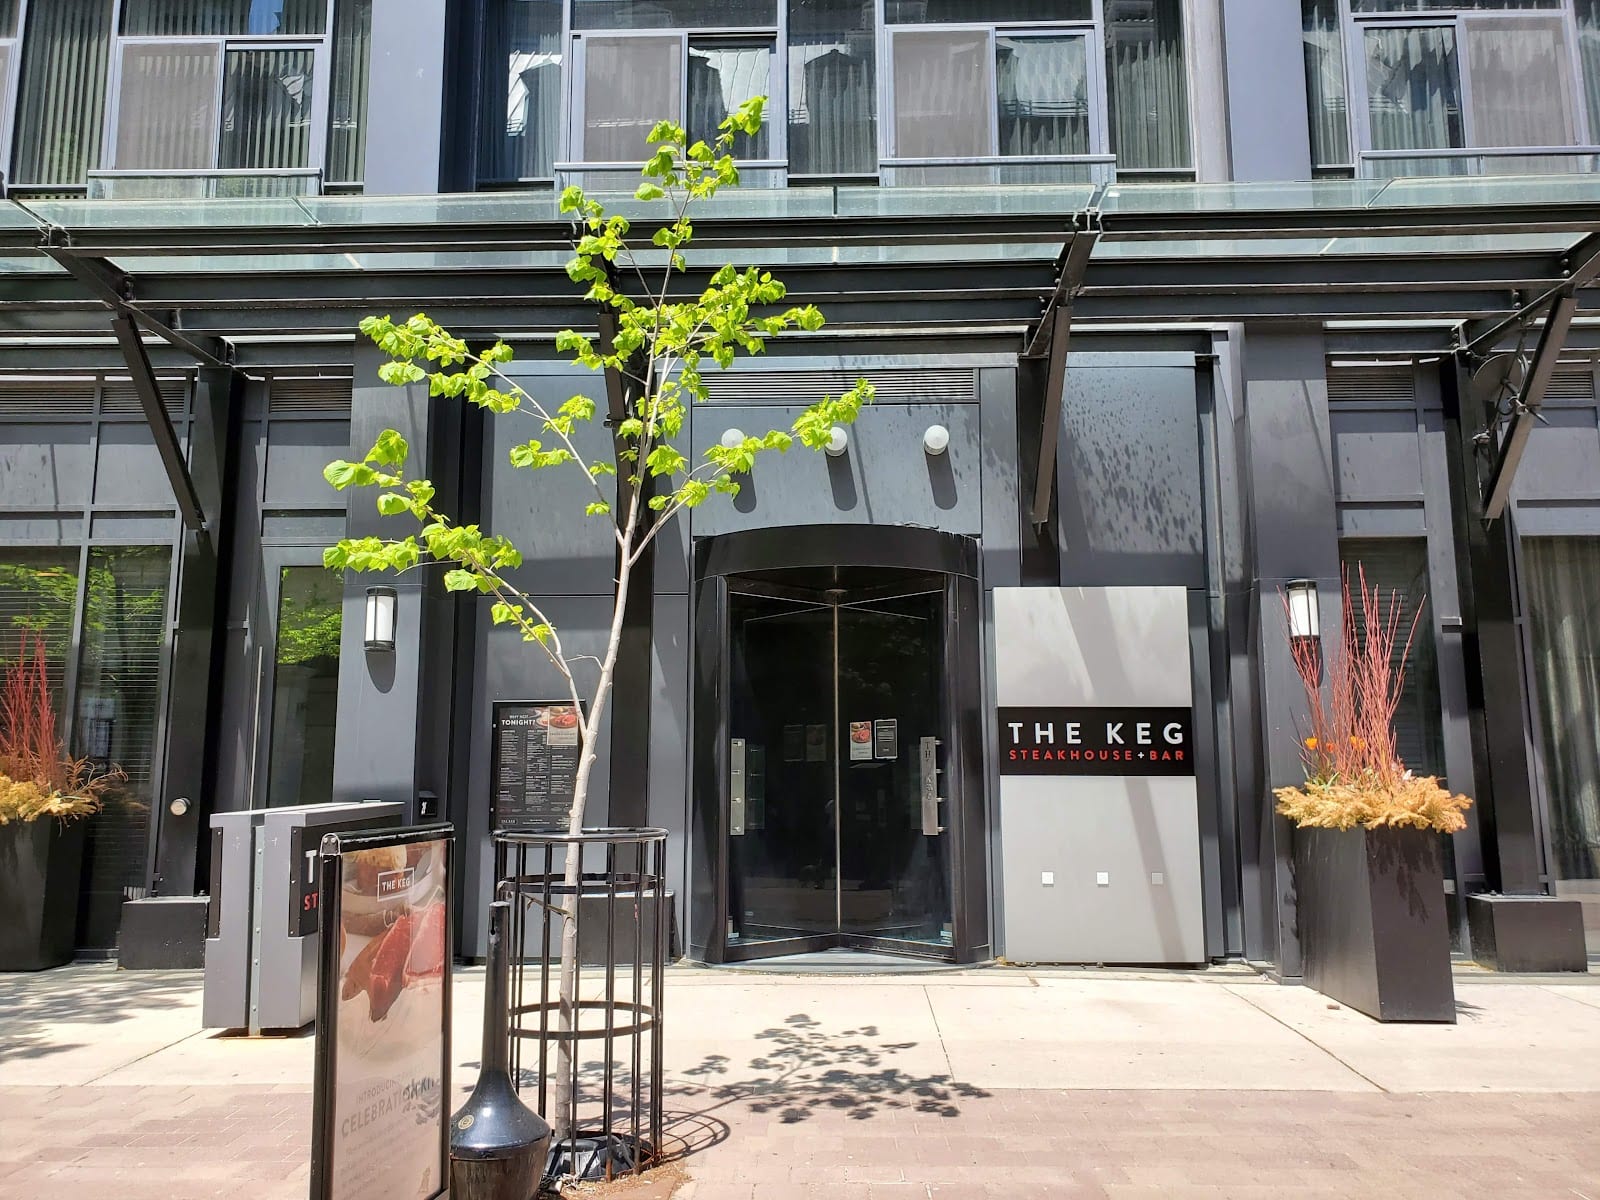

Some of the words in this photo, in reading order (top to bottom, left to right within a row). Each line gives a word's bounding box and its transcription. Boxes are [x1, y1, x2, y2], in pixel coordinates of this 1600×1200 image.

[1007, 722, 1082, 745] THE
[1106, 722, 1184, 745] KEG
[381, 880, 396, 892] THE
[397, 877, 411, 889] KEG
